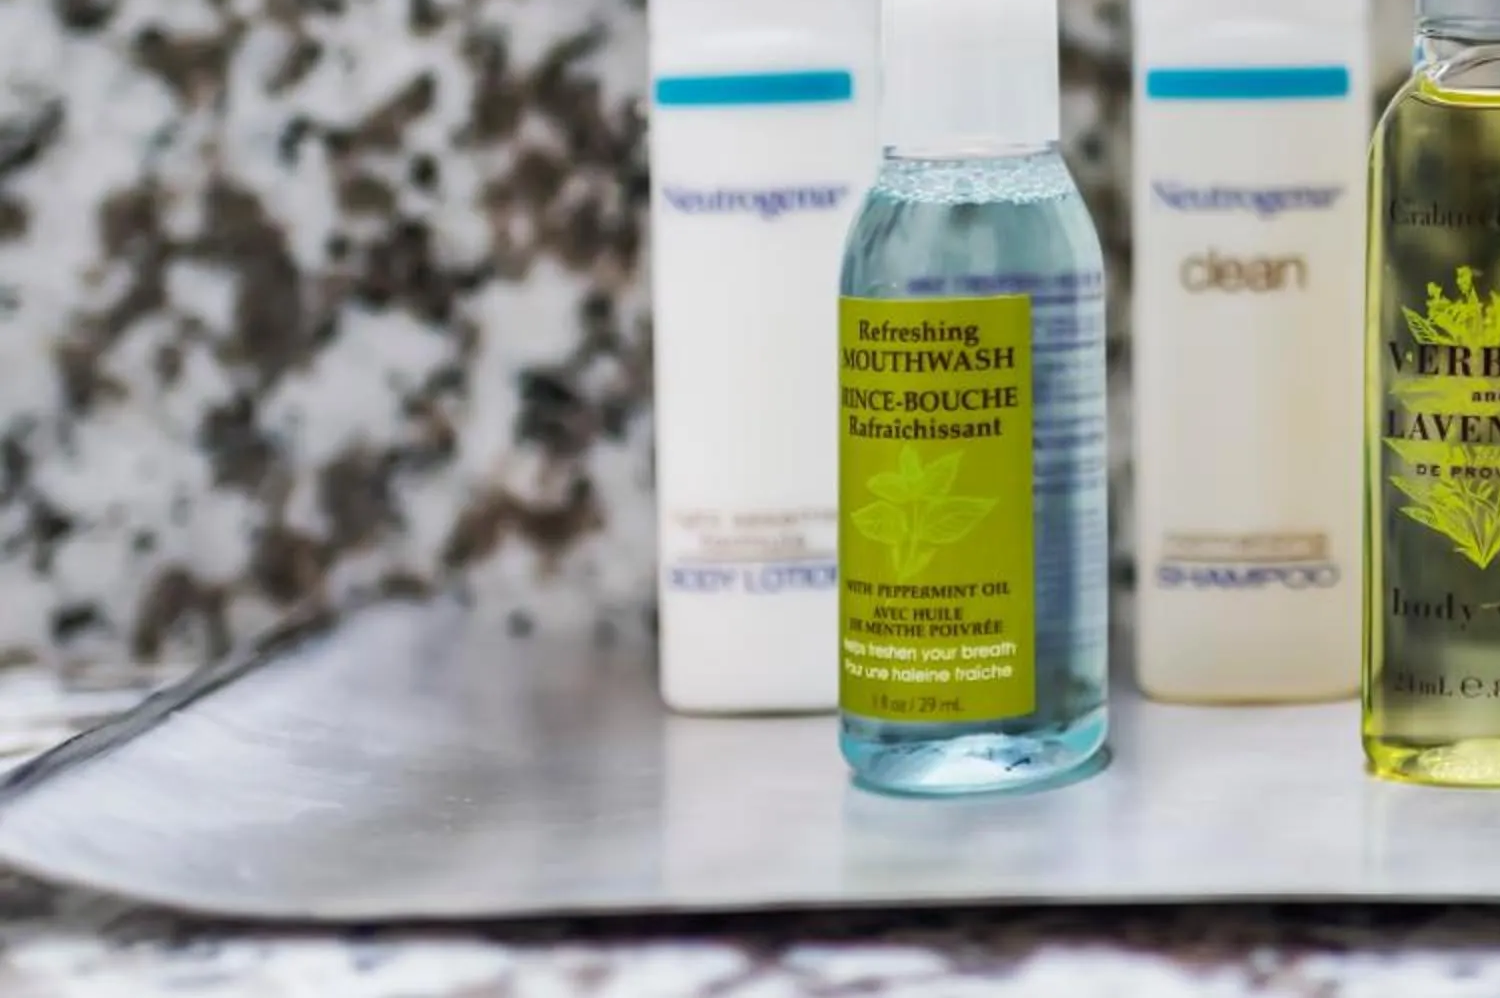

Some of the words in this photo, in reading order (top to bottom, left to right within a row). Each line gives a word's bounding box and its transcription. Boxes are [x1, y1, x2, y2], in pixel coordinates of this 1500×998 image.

[1178, 248, 1309, 294] clean
[858, 319, 981, 347] Refreshing
[842, 346, 1016, 373] MOUTHWASH
[849, 413, 1003, 440] Rafraîchissant
[1416, 463, 1441, 477] DE
[743, 564, 838, 595] LOTIO
[1157, 565, 1341, 590] SHAMPOO
[877, 582, 976, 600] PEPPERMINT
[982, 581, 1011, 595] OIL
[873, 605, 909, 621] AVEC
[913, 607, 964, 622] HUILE
[1392, 588, 1471, 629] body
[864, 620, 926, 638] MENTHE
[929, 617, 1004, 638] POIVRÉE
[922, 646, 957, 663] your
[961, 640, 1017, 659] breath
[891, 666, 951, 683] haleine
